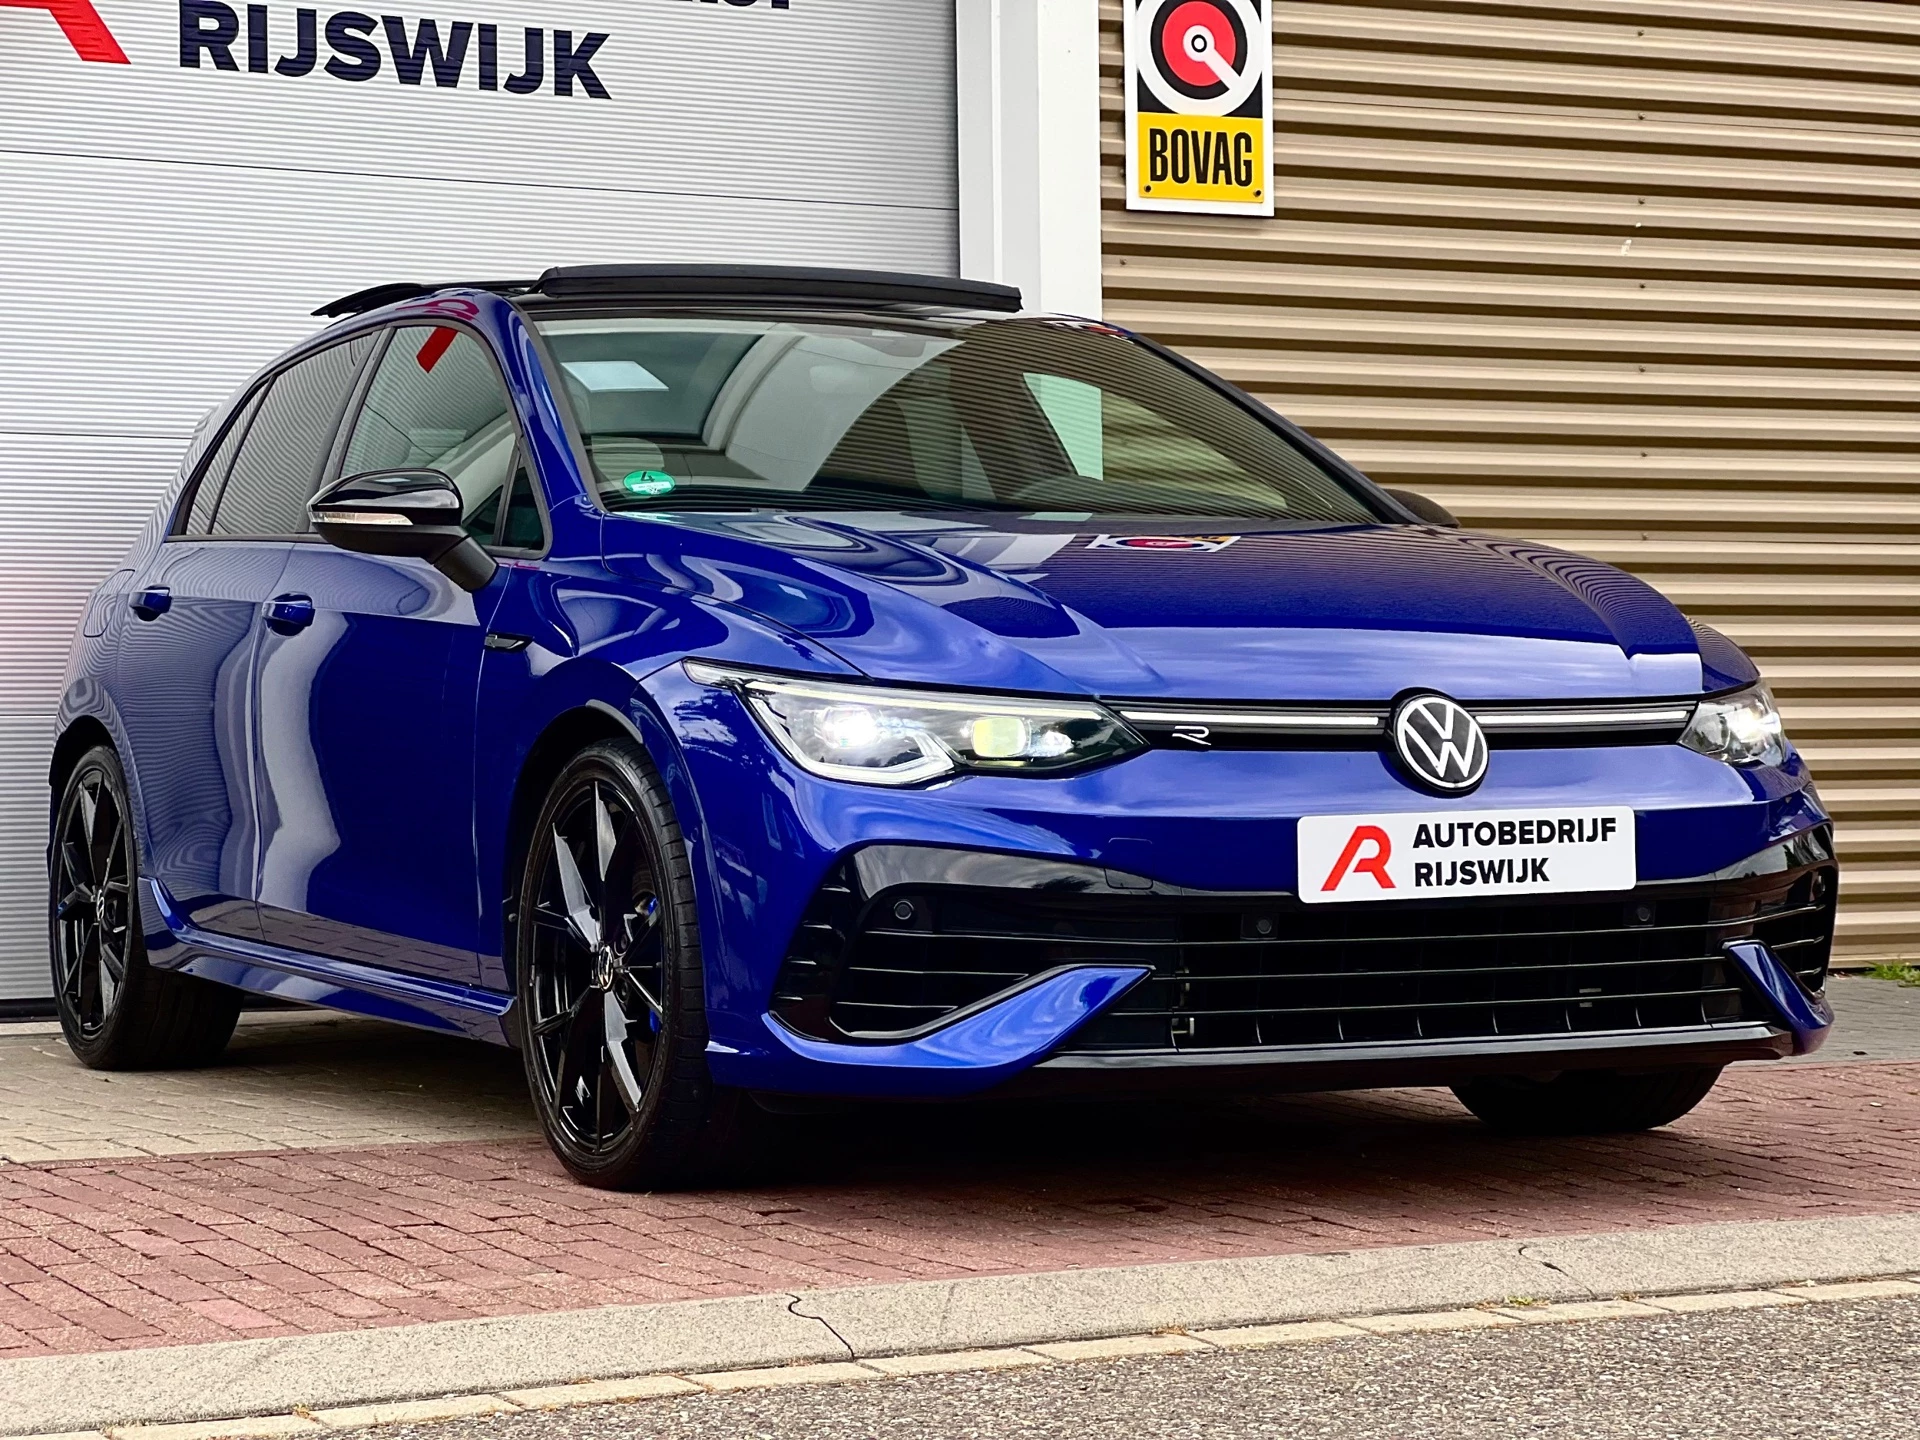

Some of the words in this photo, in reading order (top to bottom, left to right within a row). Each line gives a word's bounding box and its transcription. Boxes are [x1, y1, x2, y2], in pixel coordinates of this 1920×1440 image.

[179, 0, 612, 100] RIJSWIJK
[1149, 128, 1253, 187] BOVAG
[1412, 817, 1617, 848] AUTOBEDRIJF
[1414, 857, 1550, 888] RIJSWIJK
